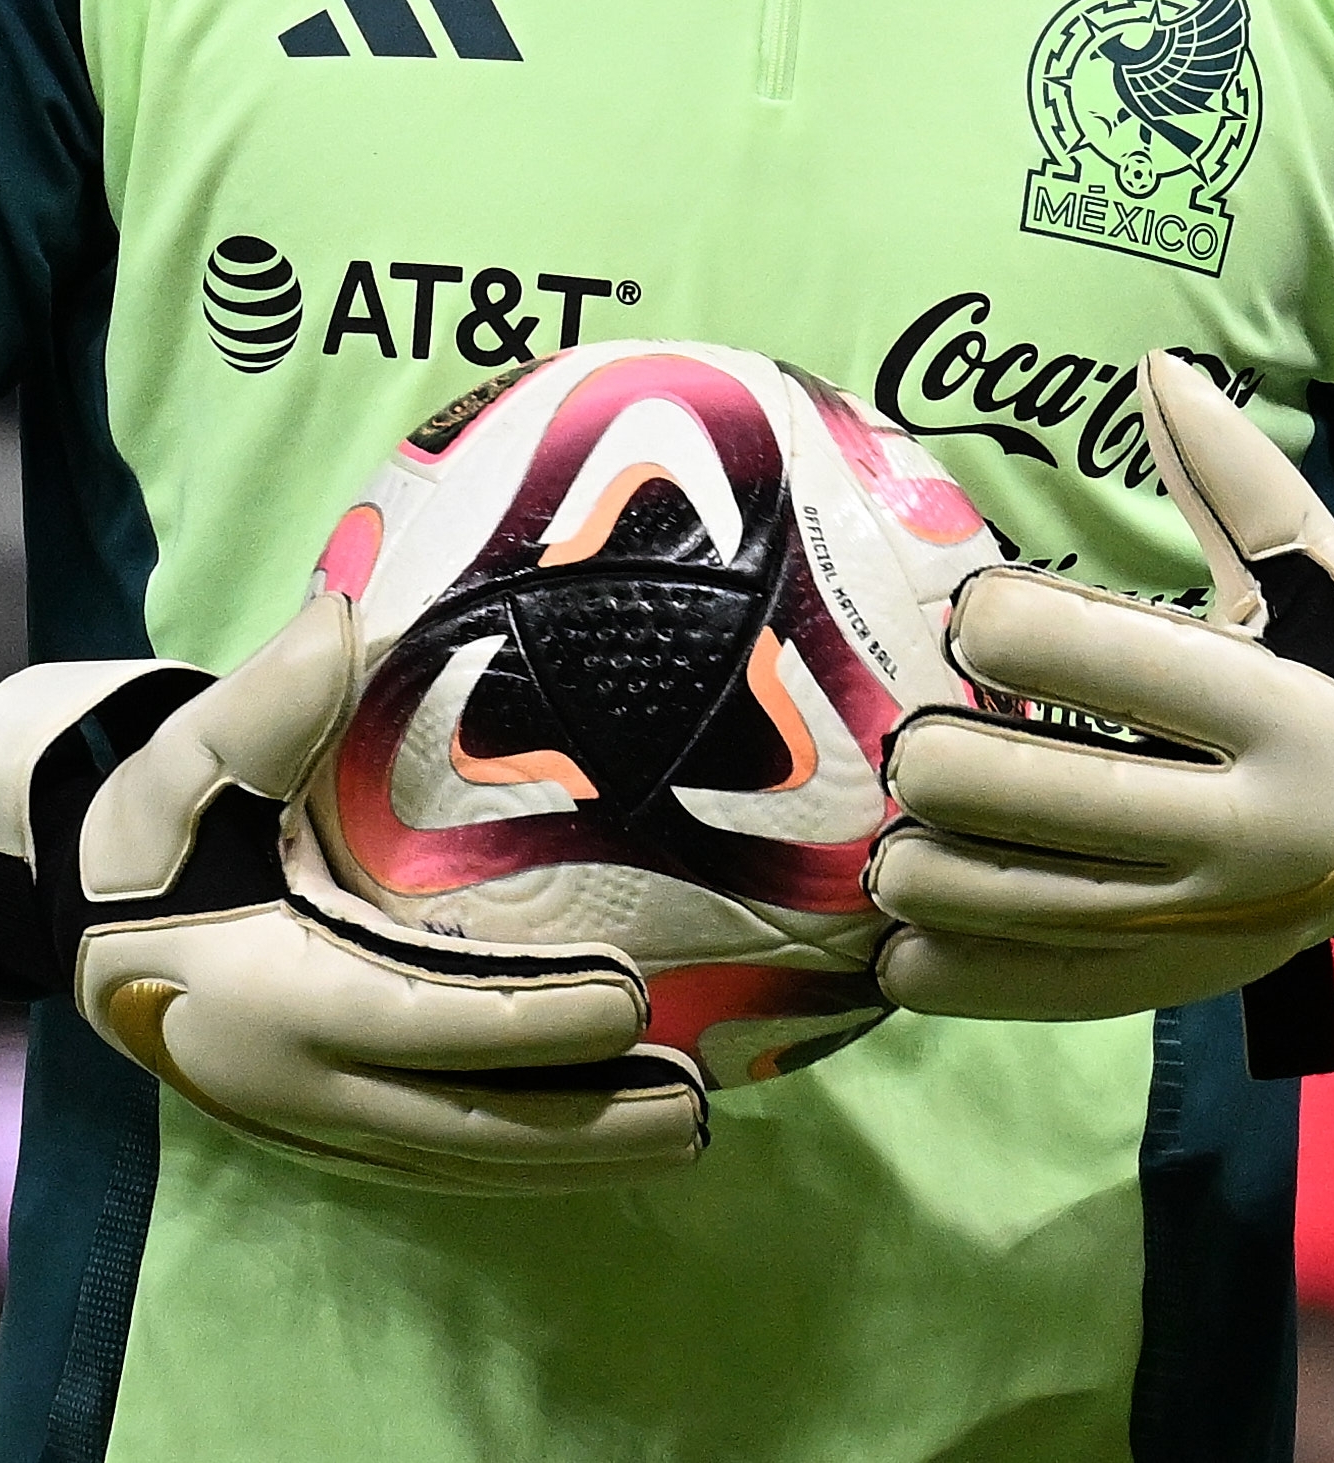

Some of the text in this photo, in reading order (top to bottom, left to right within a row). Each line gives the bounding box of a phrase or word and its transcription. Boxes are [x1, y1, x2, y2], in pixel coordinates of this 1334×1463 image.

[1033, 185, 1218, 260] MÉXICO
[803, 505, 899, 681] OFFICIAL MATCH BALL
